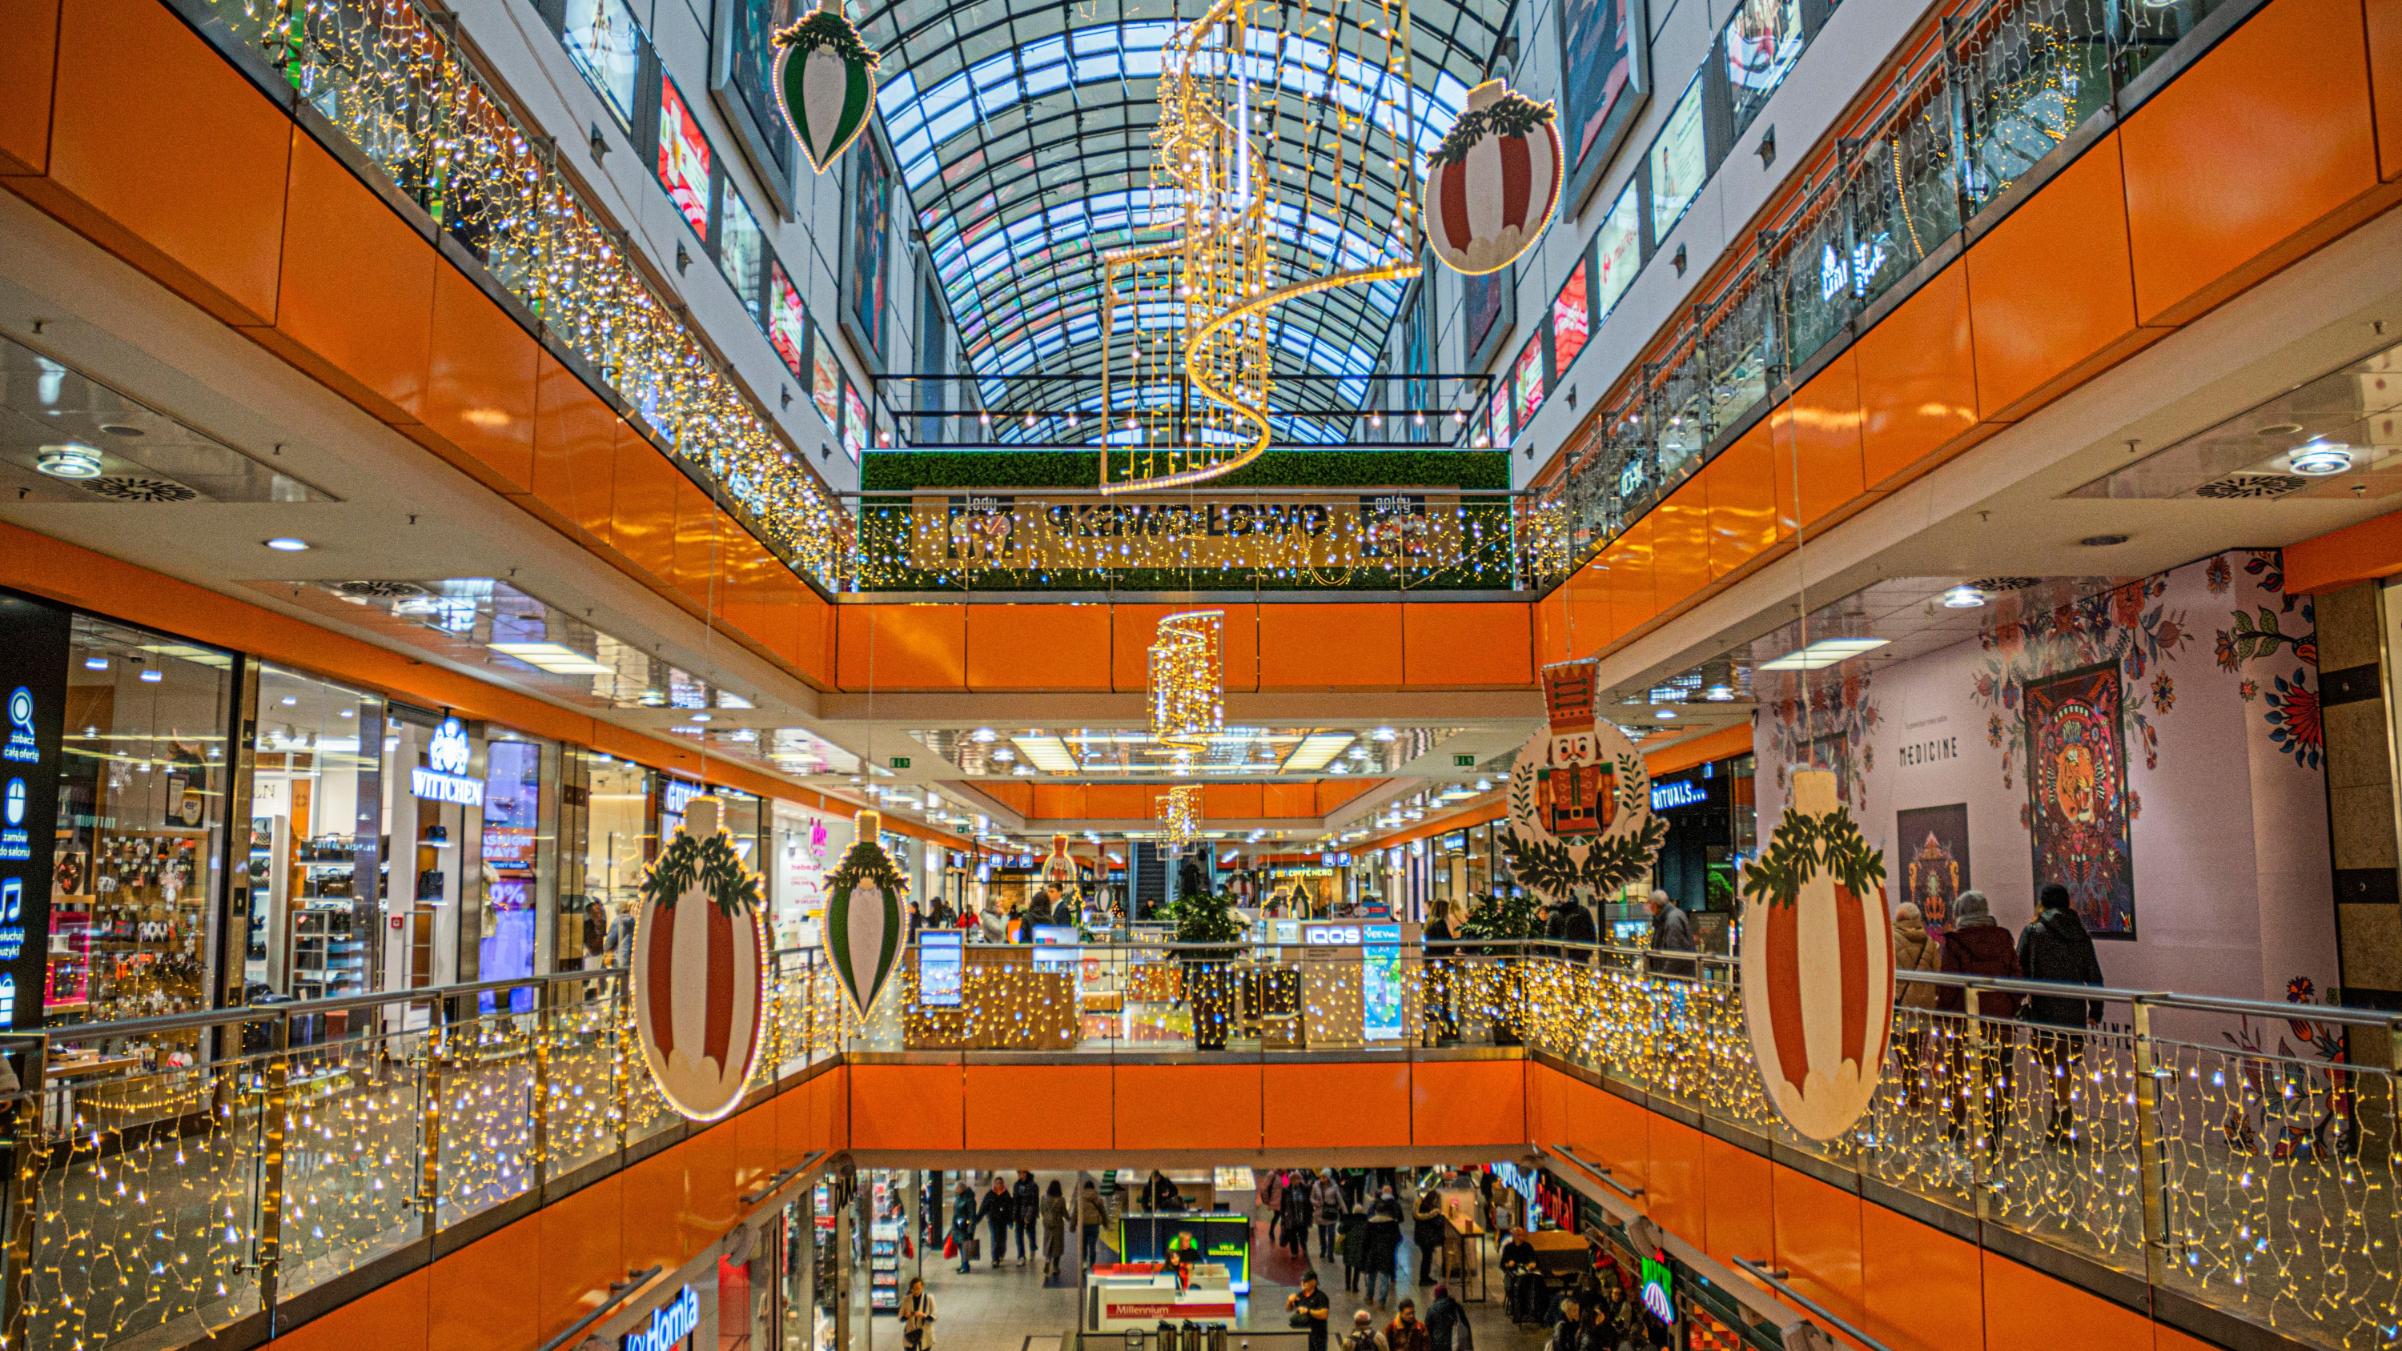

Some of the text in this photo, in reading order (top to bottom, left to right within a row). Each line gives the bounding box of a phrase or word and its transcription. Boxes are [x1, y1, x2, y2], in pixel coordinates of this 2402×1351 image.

[11, 733, 36, 745] zobacz
[1899, 736, 1958, 767] MEDICINE
[411, 769, 485, 807] WITTCHEN
[667, 783, 704, 812] GUE
[3, 829, 29, 843] zamów
[9, 846, 31, 858] salonu
[482, 846, 520, 858] DAYS
[1306, 928, 1361, 945] IQOS
[2091, 1022, 2132, 1050] CINE
[1115, 1304, 1169, 1314] Millennium
